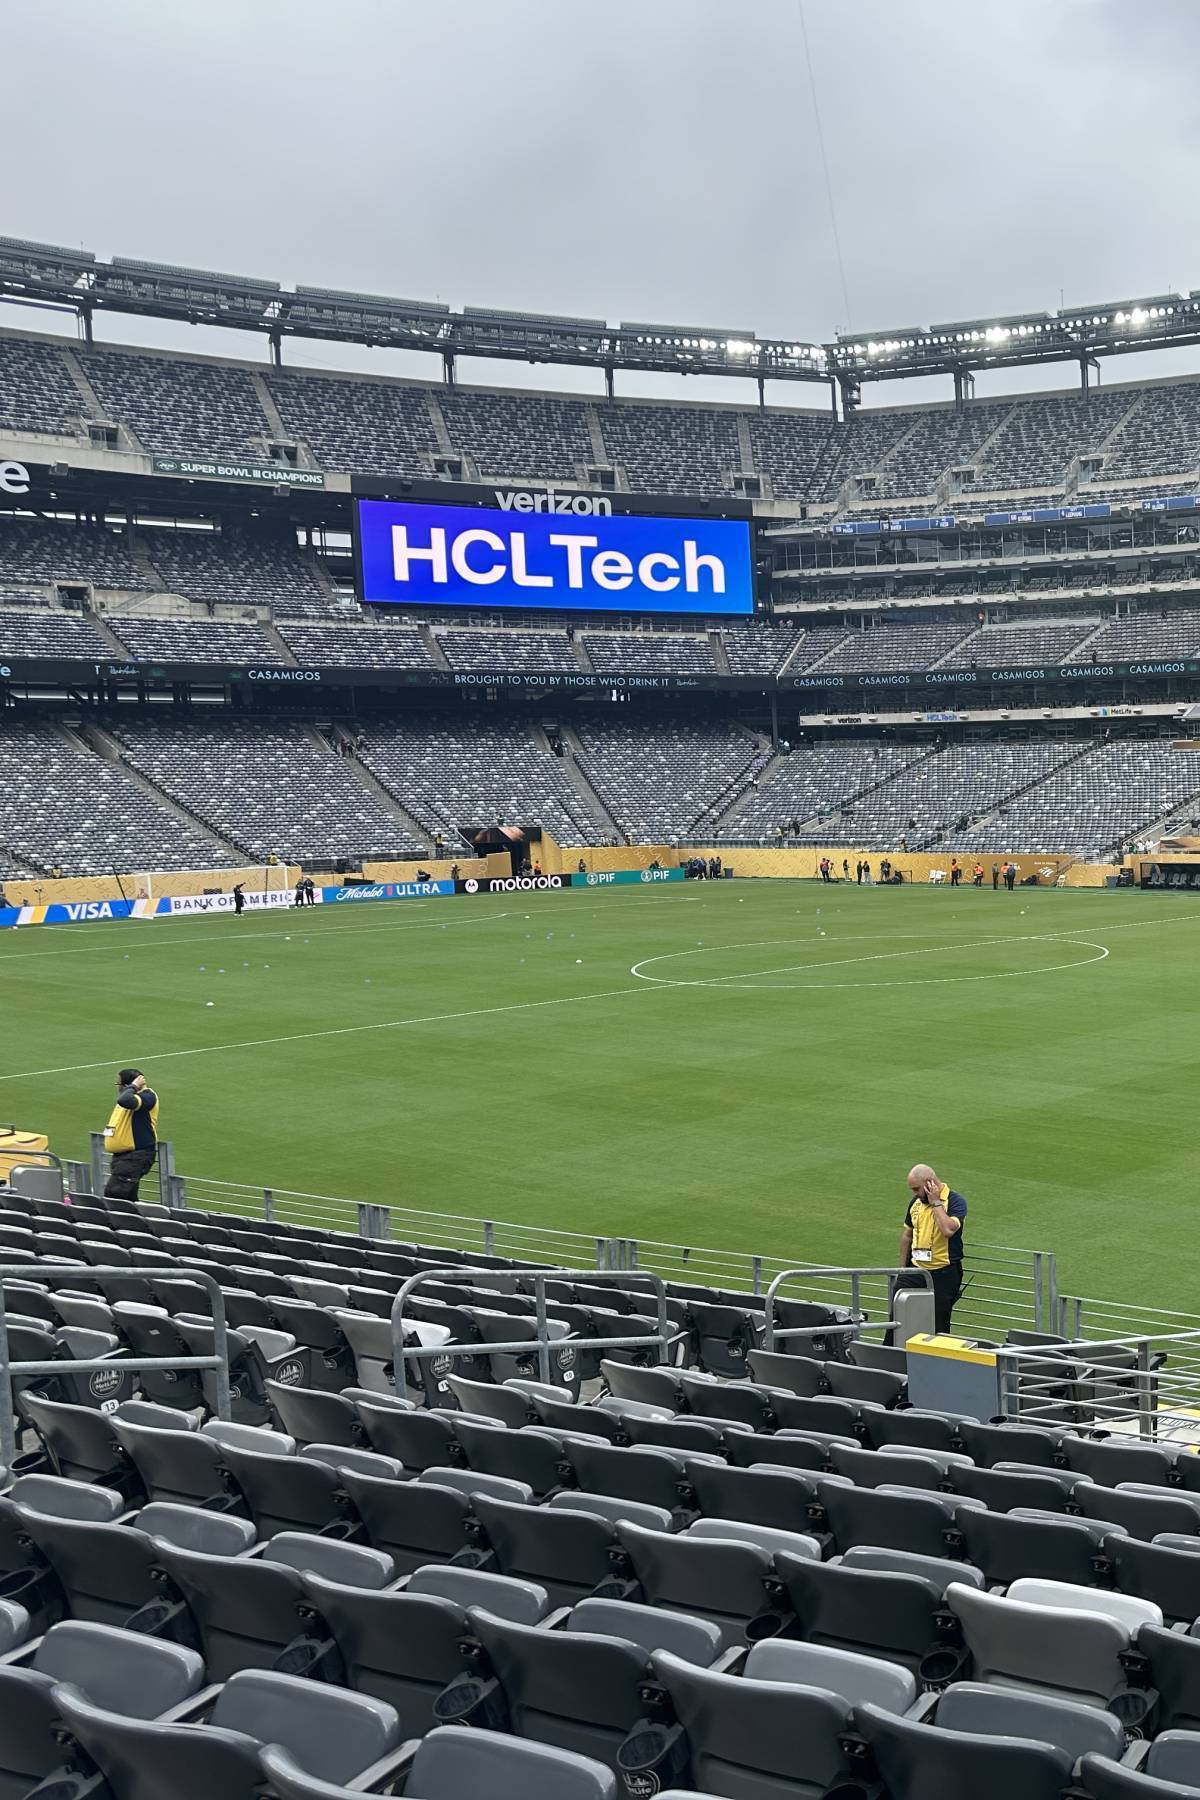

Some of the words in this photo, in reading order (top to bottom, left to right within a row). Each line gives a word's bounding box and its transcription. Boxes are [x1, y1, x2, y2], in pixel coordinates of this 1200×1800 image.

[181, 462, 216, 475] SUPER
[218, 465, 251, 478] BOWL
[253, 469, 261, 479] III
[262, 470, 323, 485] CHAMPIONS
[495, 488, 612, 517] verizon
[391, 524, 726, 593] HCLTech
[1060, 667, 1114, 678] CASAMIGOS
[1129, 663, 1185, 675] CASAMIGOS
[248, 670, 321, 681] CASAMIGOS
[454, 674, 504, 684] BROUGHT
[507, 675, 521, 685] TO
[524, 676, 546, 685] YOU
[550, 676, 561, 685] BY
[563, 676, 596, 686] THOSE
[599, 677, 626, 686] WHO
[629, 677, 658, 687] DRINK
[661, 678, 669, 687] IT
[858, 675, 910, 685] CASAMIGOS
[925, 673, 977, 683] CASAMIGOS
[992, 670, 1045, 681] CASAMIGOS
[794, 677, 844, 687] CASAMIGOS
[1110, 707, 1132, 716] MetLife
[837, 716, 862, 724] verizon
[599, 873, 615, 883] PIF
[653, 870, 670, 880] PIF
[490, 874, 562, 892] motorola
[336, 886, 384, 902] Michelob
[396, 881, 440, 896] ULTRA
[174, 896, 214, 910] BANK
[218, 895, 235, 906] OF
[64, 902, 113, 920] VISA
